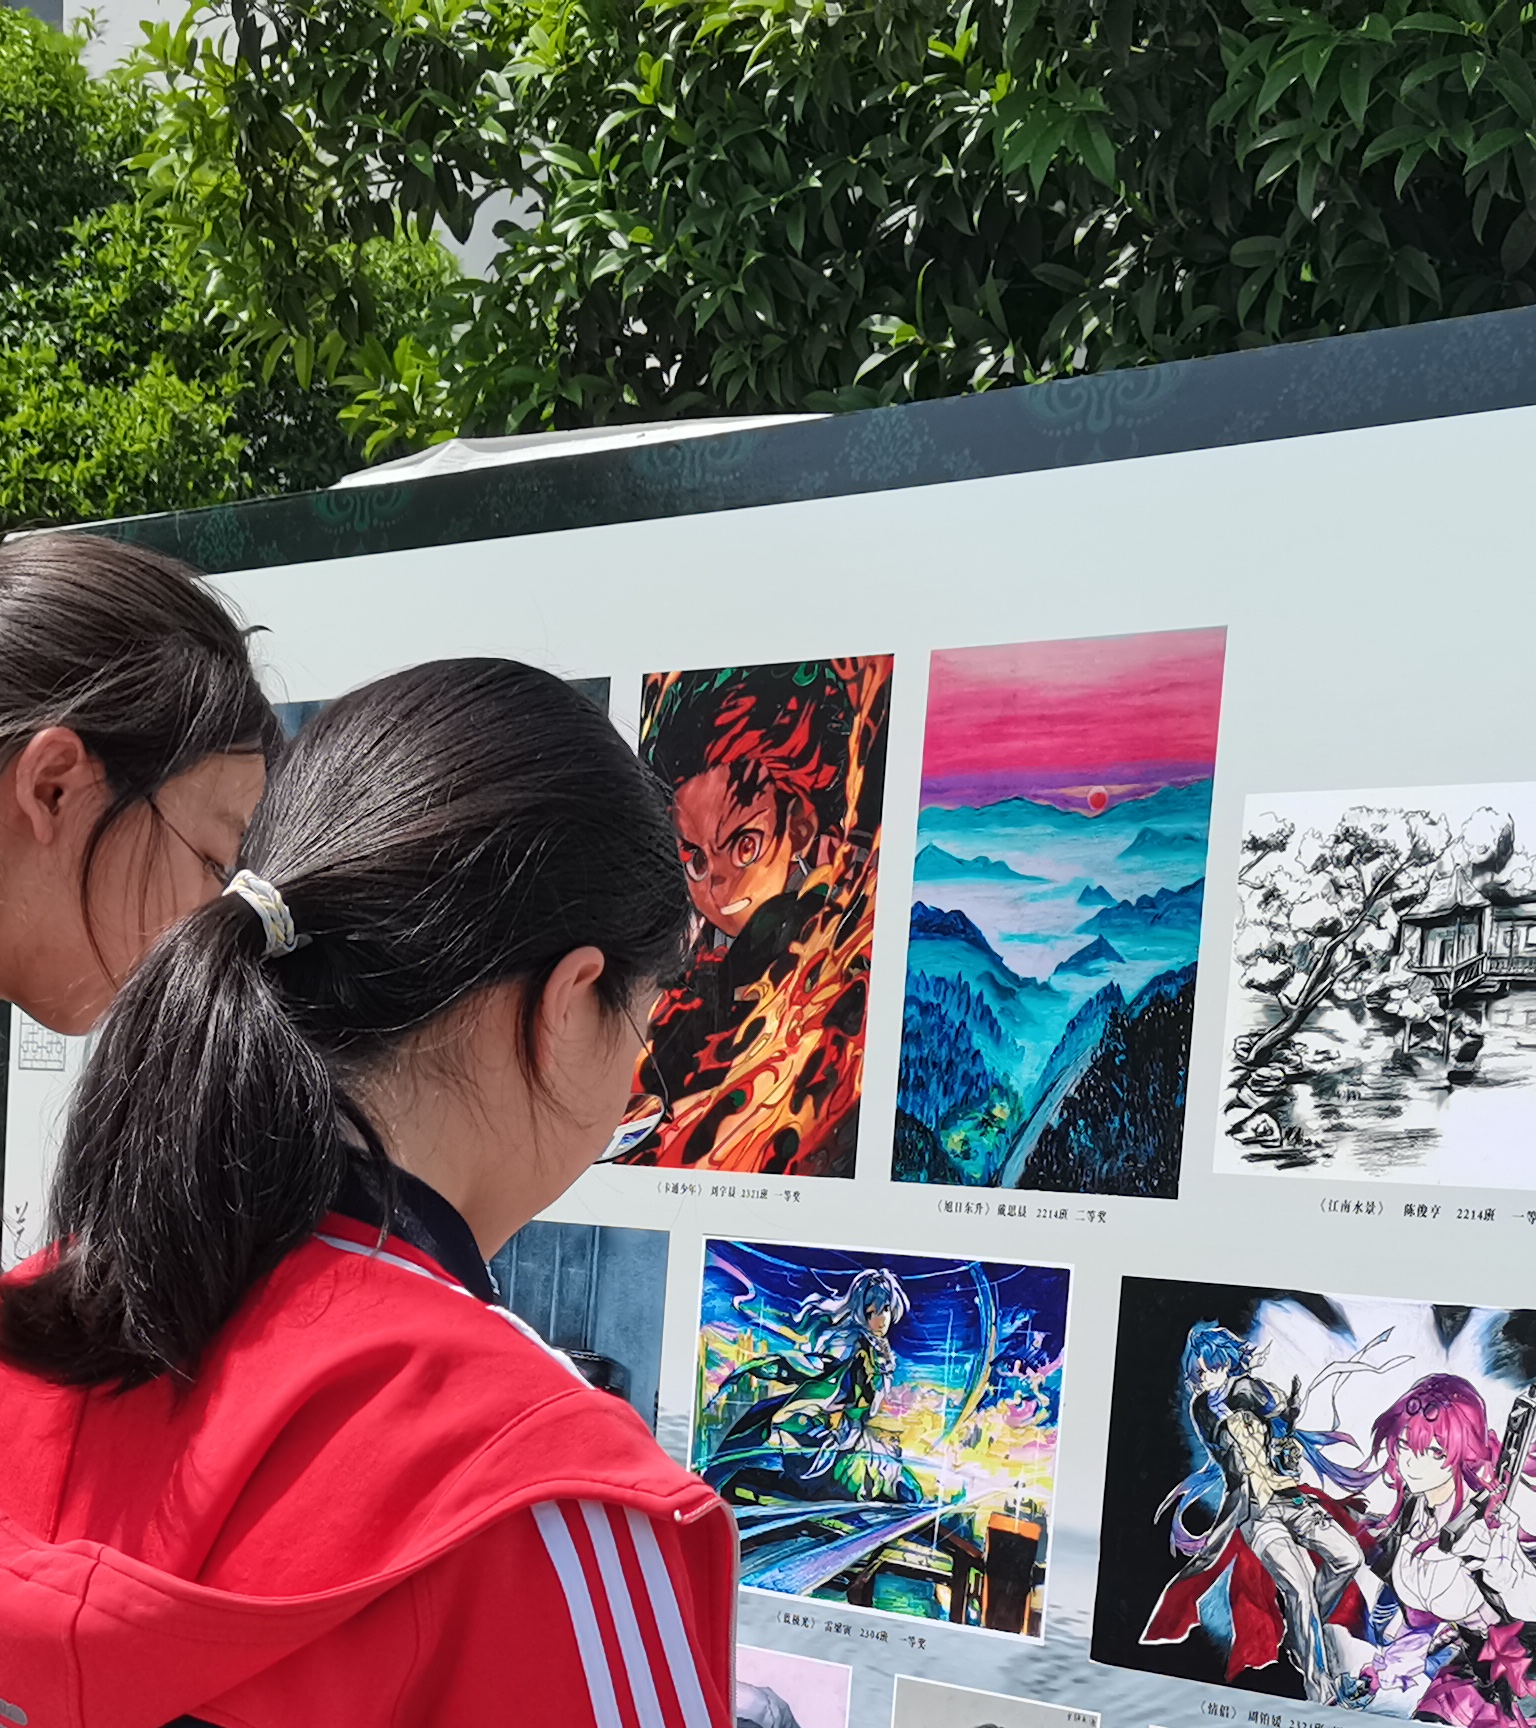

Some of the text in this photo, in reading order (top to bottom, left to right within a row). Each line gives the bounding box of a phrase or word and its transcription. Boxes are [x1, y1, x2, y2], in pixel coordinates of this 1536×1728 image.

[741, 1188, 769, 1201] 2321班
[774, 1190, 801, 1203] 一等奖
[936, 1200, 991, 1216] 《旭日东升》
[1036, 1207, 1069, 1221] 2214班
[1075, 1209, 1107, 1224] 二等奖
[1318, 1197, 1385, 1216] 《江南水景》
[1456, 1207, 1497, 1222] 2214班
